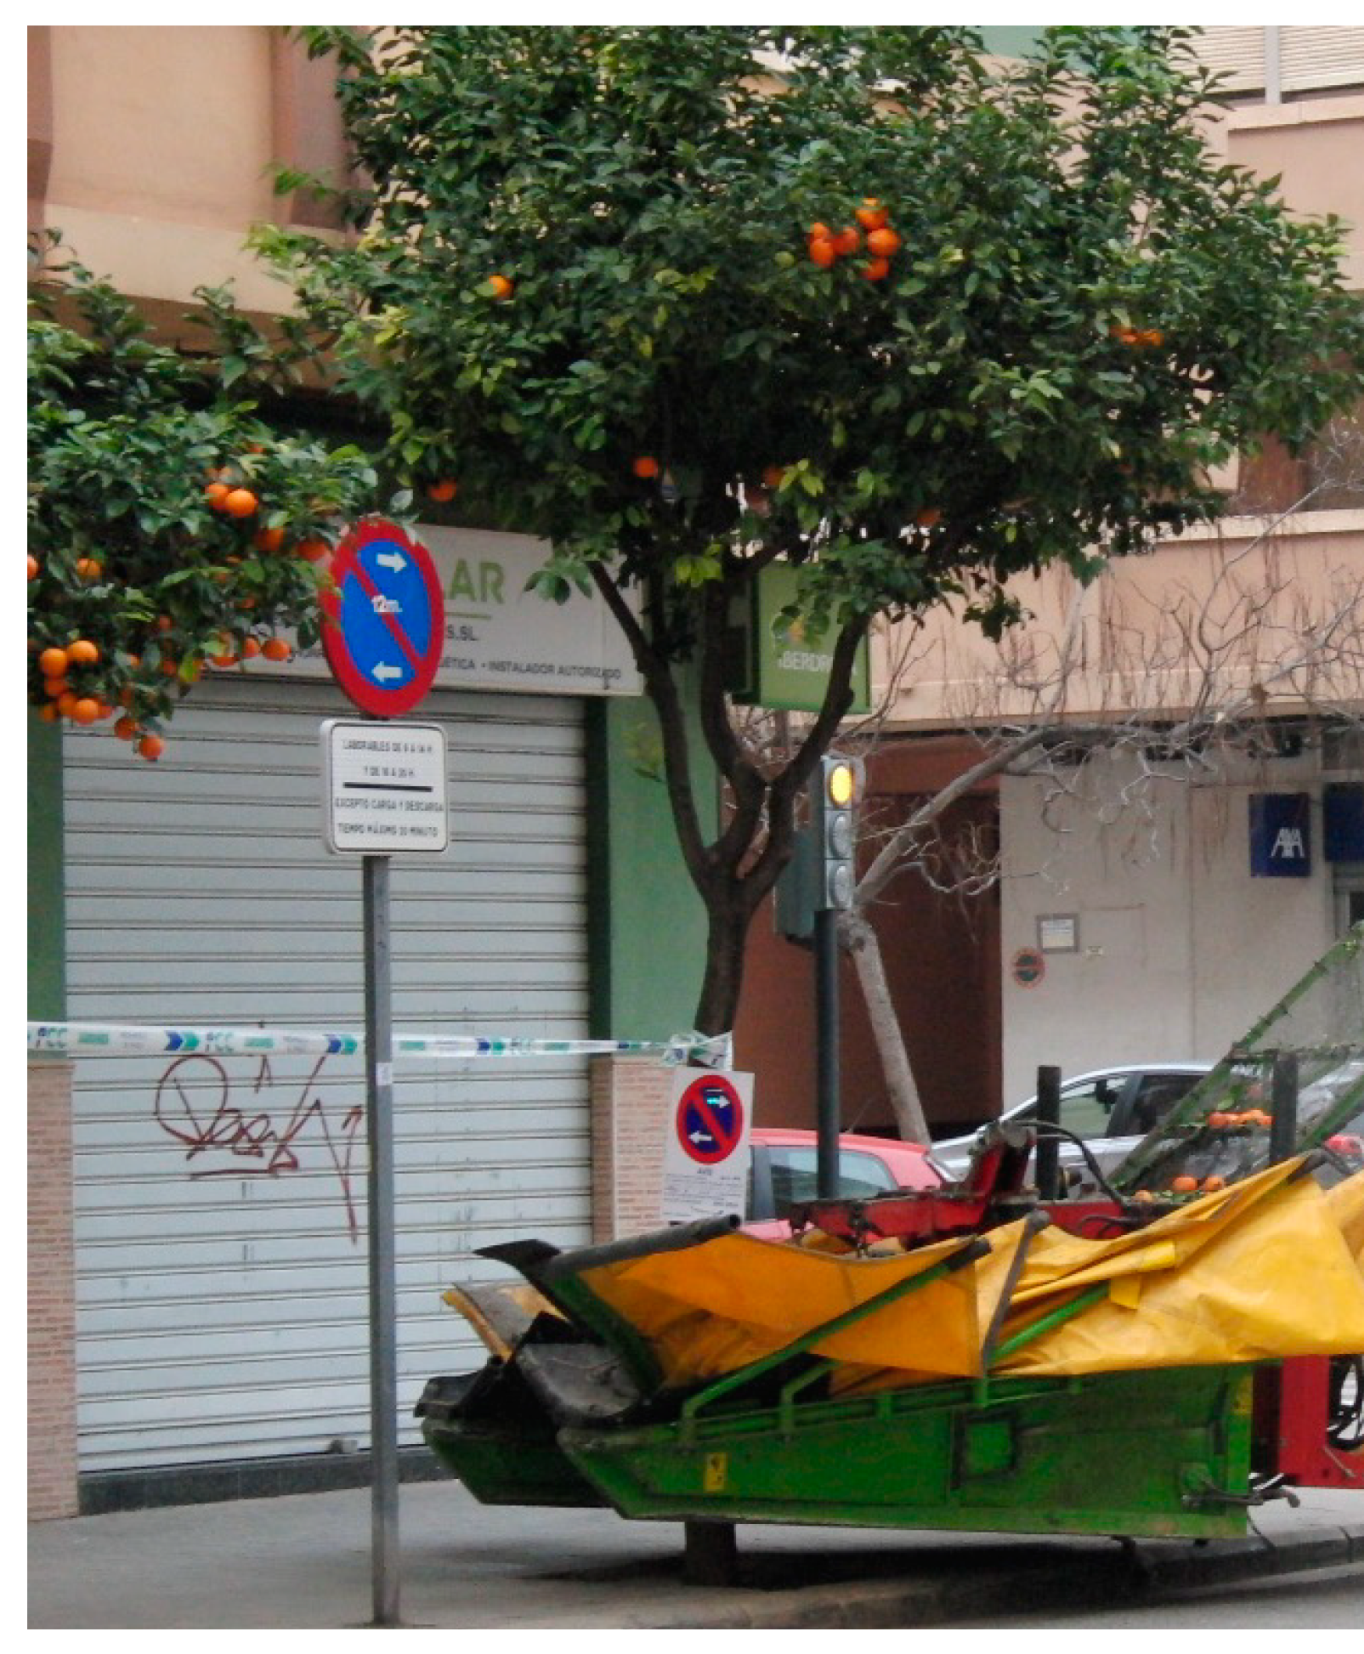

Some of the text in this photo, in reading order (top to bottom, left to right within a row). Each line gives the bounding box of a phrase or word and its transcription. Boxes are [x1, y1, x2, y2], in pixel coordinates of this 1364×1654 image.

[445, 557, 505, 604] AR
[488, 660, 555, 676] INSTALADOR
[557, 665, 621, 679] AUTORIZADO
[343, 739, 390, 752] LABORABLES
[335, 797, 369, 809] EXCEPTO
[371, 799, 396, 810] CARGA
[405, 801, 444, 812] DESCARGA
[338, 822, 364, 834] TIEMPO
[1270, 826, 1305, 858] AXA
